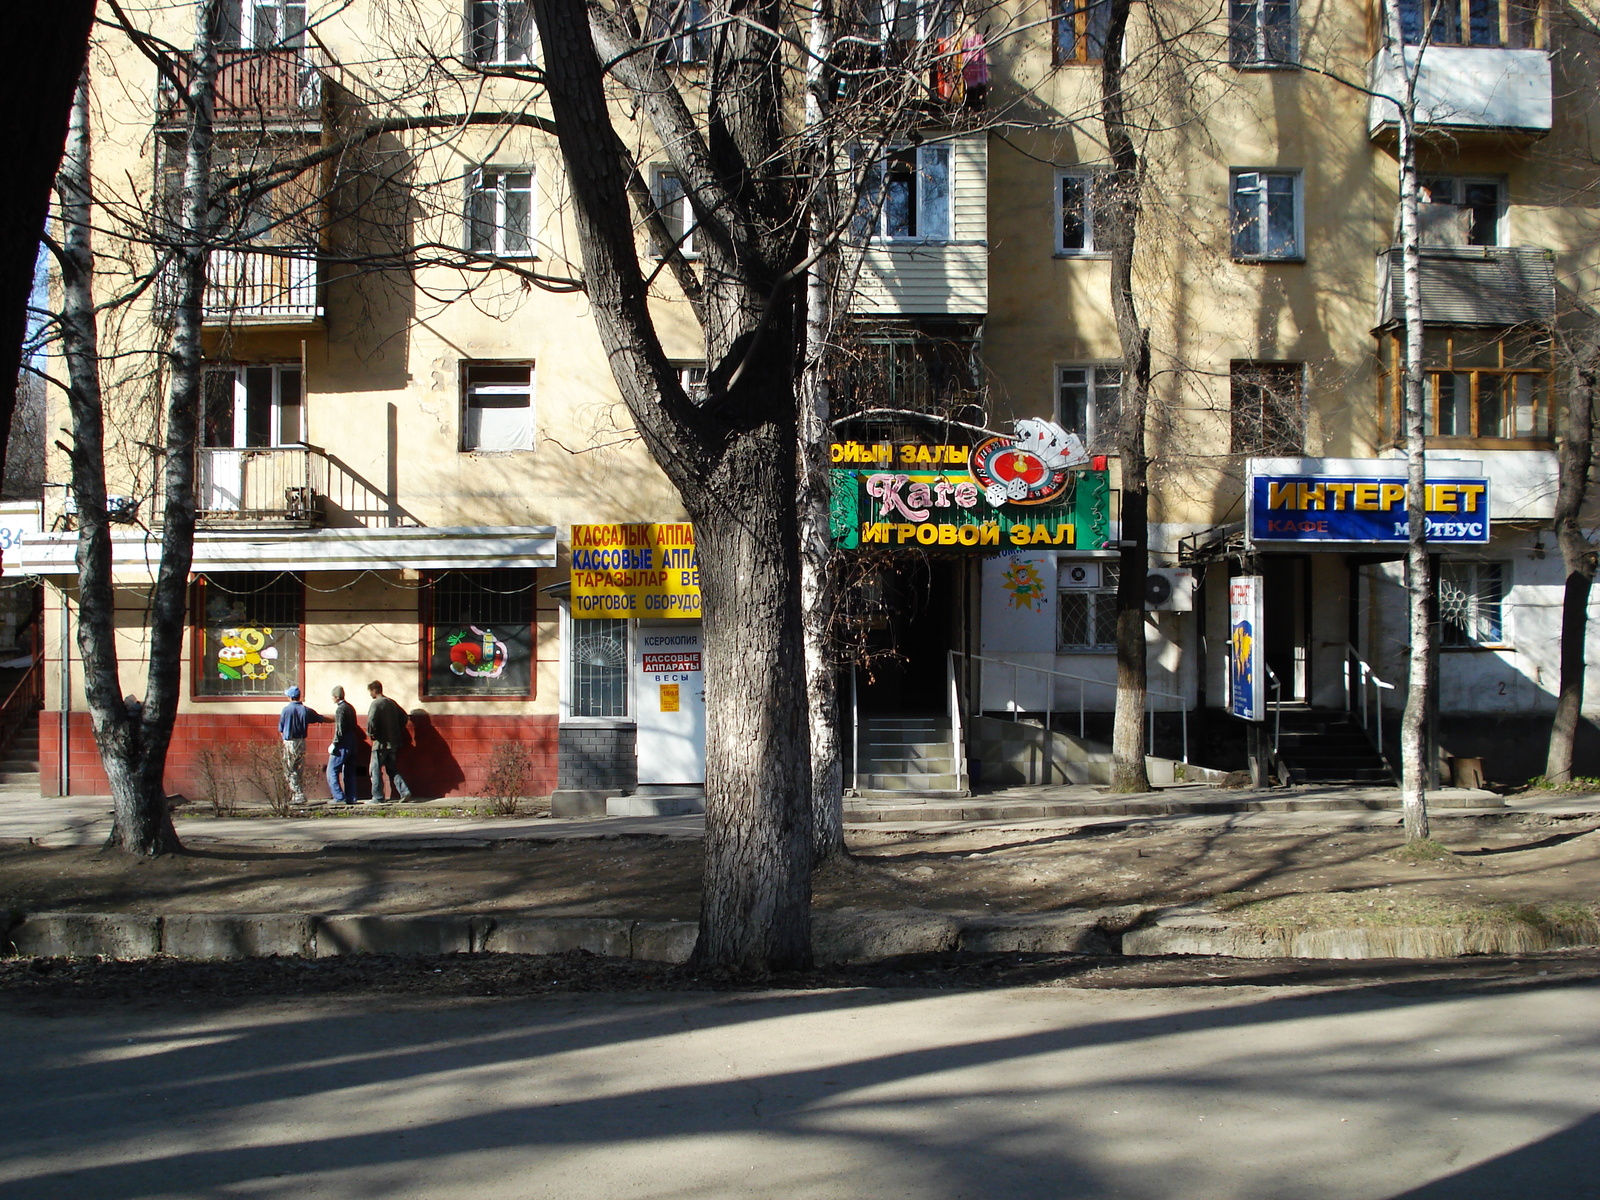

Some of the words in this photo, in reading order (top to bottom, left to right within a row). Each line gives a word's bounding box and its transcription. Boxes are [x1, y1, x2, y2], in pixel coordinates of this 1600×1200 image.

[900, 445, 968, 464] ЗАЛЫ
[862, 521, 1000, 545] ИГРОВОЙ
[1009, 524, 1075, 545] ЗАЛ
[1268, 520, 1328, 532] КАФЕ
[573, 525, 651, 547] КАССАЛЫҚ
[656, 525, 696, 545] АППА
[573, 549, 653, 570] КАССОВЫЕ
[575, 571, 668, 587] ТАРАЗЫЛАР
[577, 595, 637, 611] ТОРГОВОЕ
[644, 635, 698, 646] КСЕРОКОПИЯ
[645, 654, 699, 663] КАССОВЫЕ
[645, 662, 700, 671] АППАРАТЫ
[655, 674, 689, 682] ВЕСЫ
[1498, 681, 1506, 695] 2
